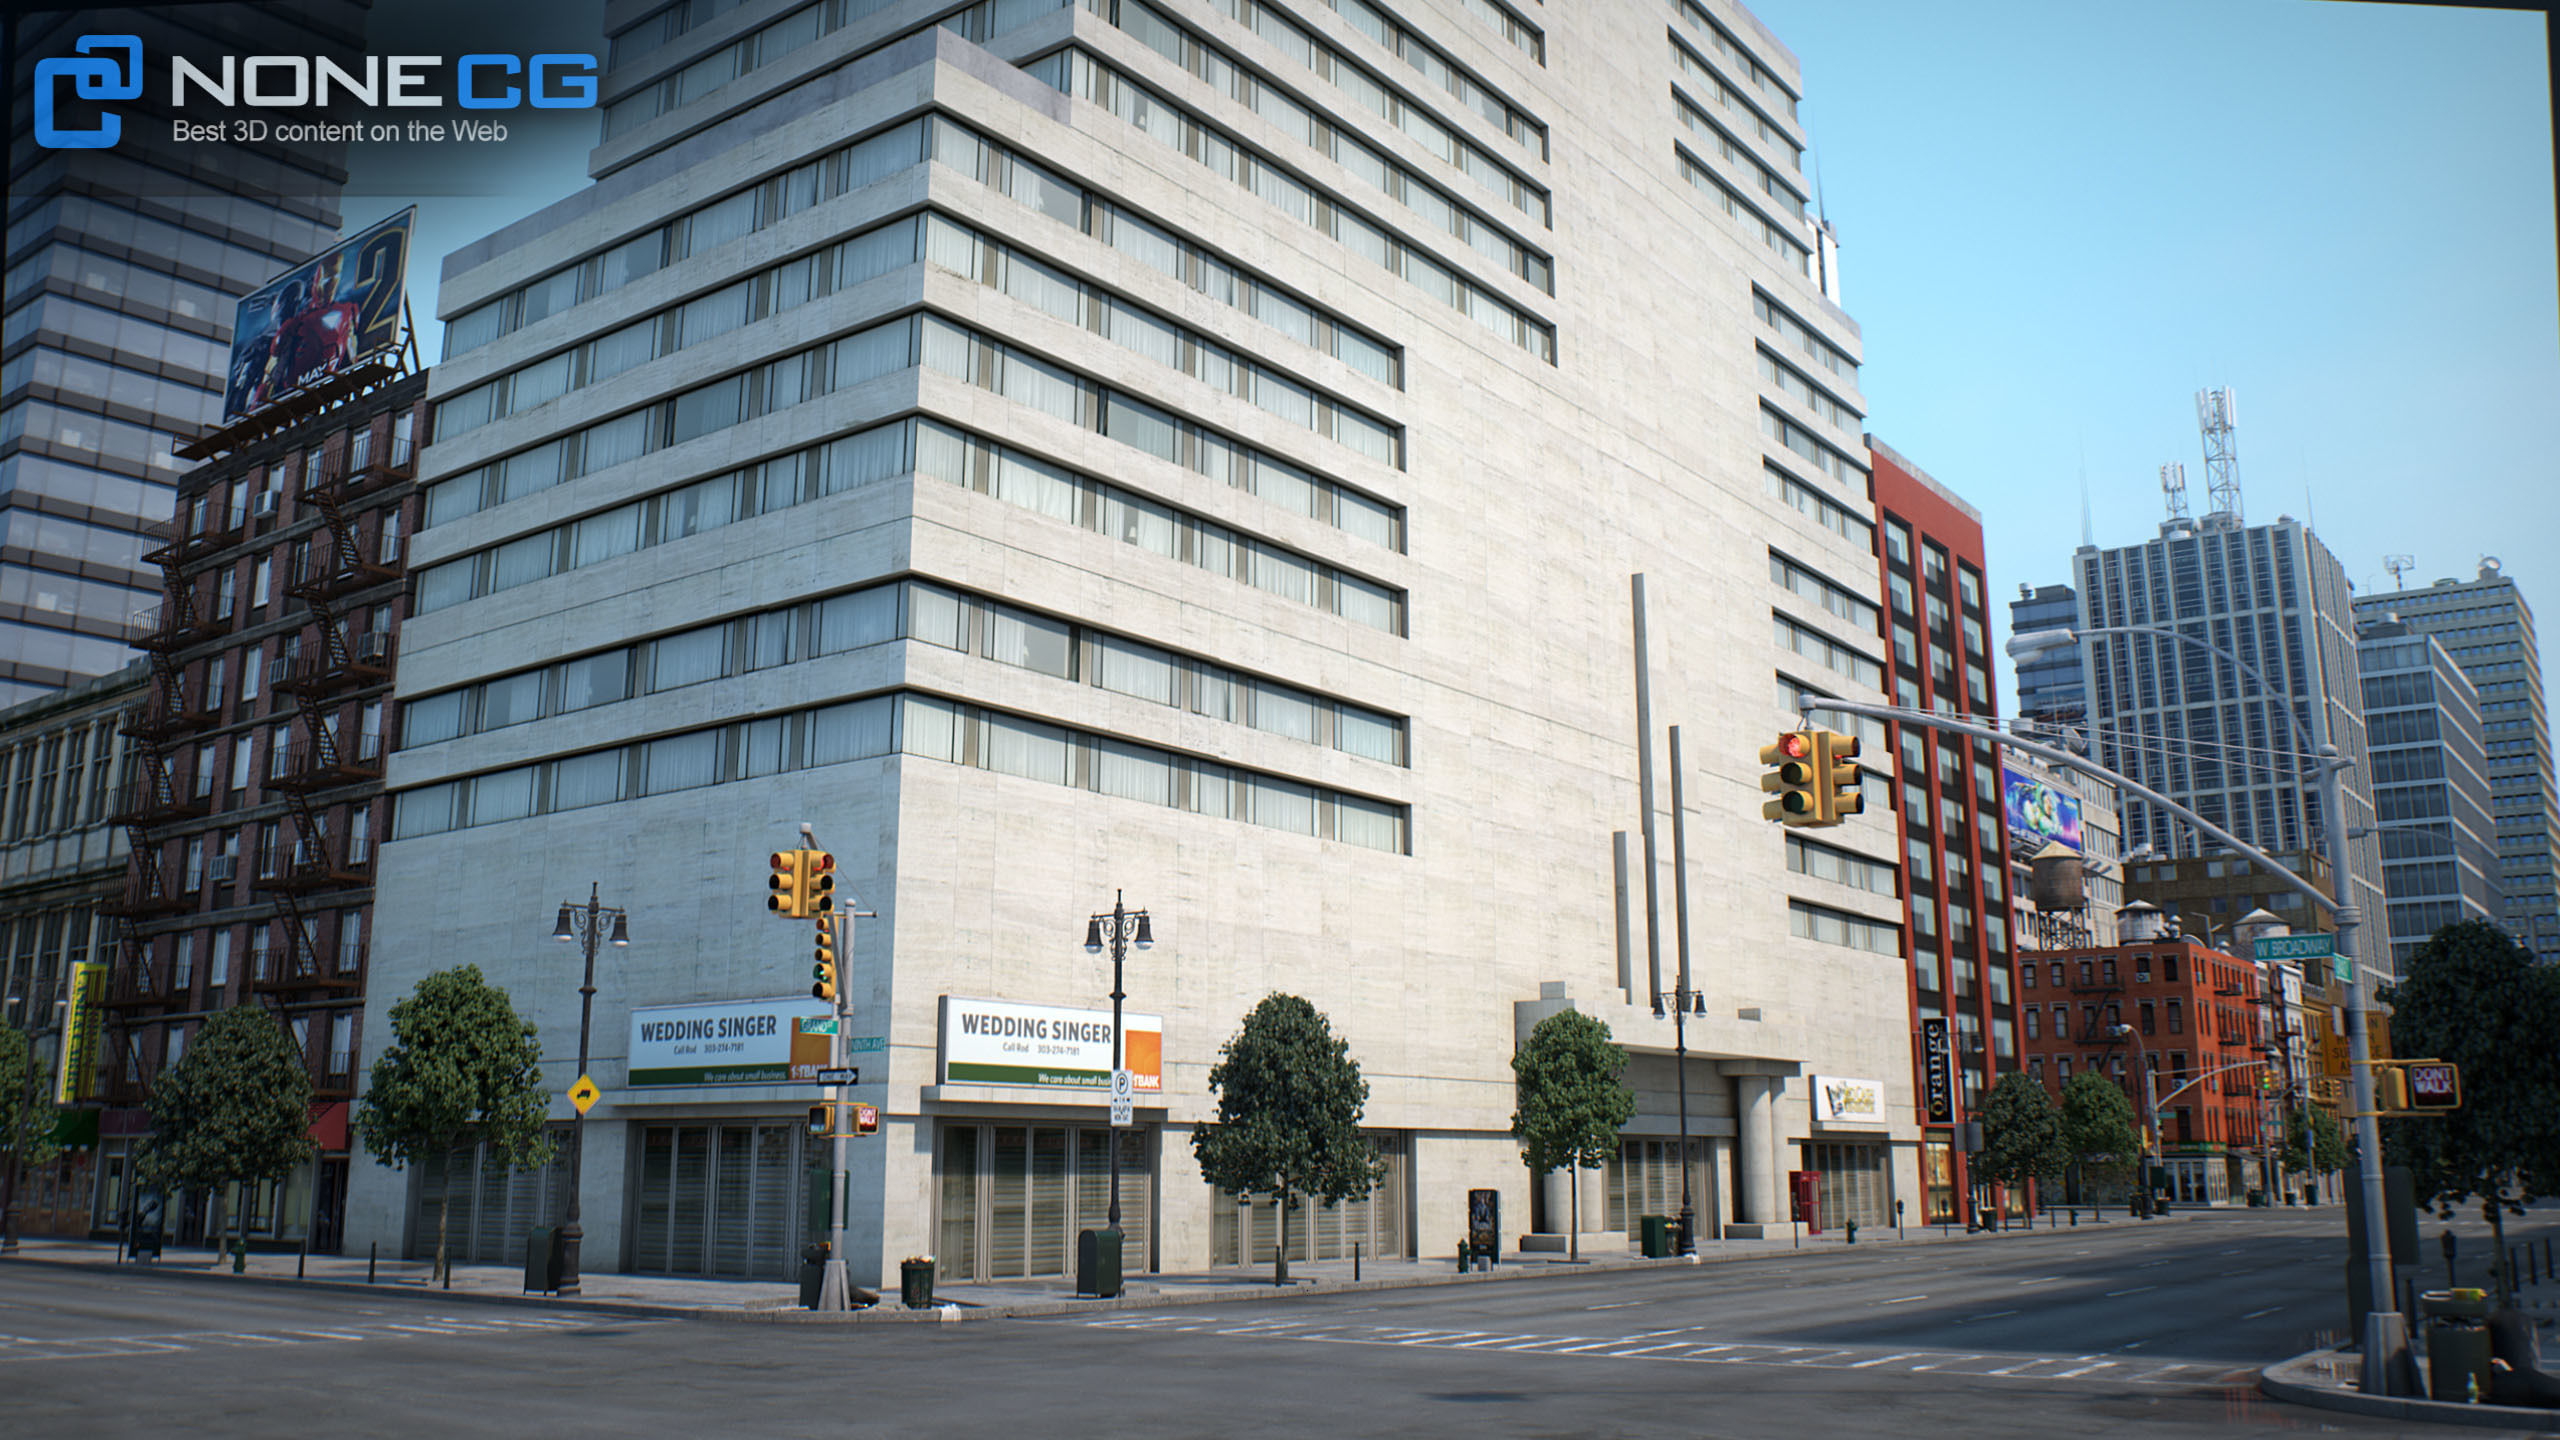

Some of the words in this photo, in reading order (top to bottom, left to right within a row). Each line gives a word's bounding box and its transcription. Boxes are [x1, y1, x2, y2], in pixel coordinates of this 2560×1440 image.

[355, 227, 406, 362] 2
[298, 365, 326, 385] MAY
[2256, 942, 2267, 956] W
[2271, 938, 2332, 956] BROADWAY
[641, 1019, 713, 1042] WEDDING
[718, 1015, 777, 1037] SINGER
[962, 1013, 1047, 1039] WEDDING
[1052, 1021, 1111, 1043] SINGER
[674, 1045, 687, 1055] Call
[851, 1038, 872, 1050] NINTH
[1003, 1042, 1015, 1052] Call
[1016, 1043, 1029, 1053] Rod
[728, 1071, 744, 1080] about
[745, 1070, 760, 1080] small
[1038, 1073, 1049, 1083] We
[1064, 1074, 1081, 1085] about
[1082, 1075, 1097, 1086] small
[2413, 1067, 2452, 1081] DONT
[1119, 1077, 1125, 1090] P
[2414, 1079, 2454, 1094] WALK
